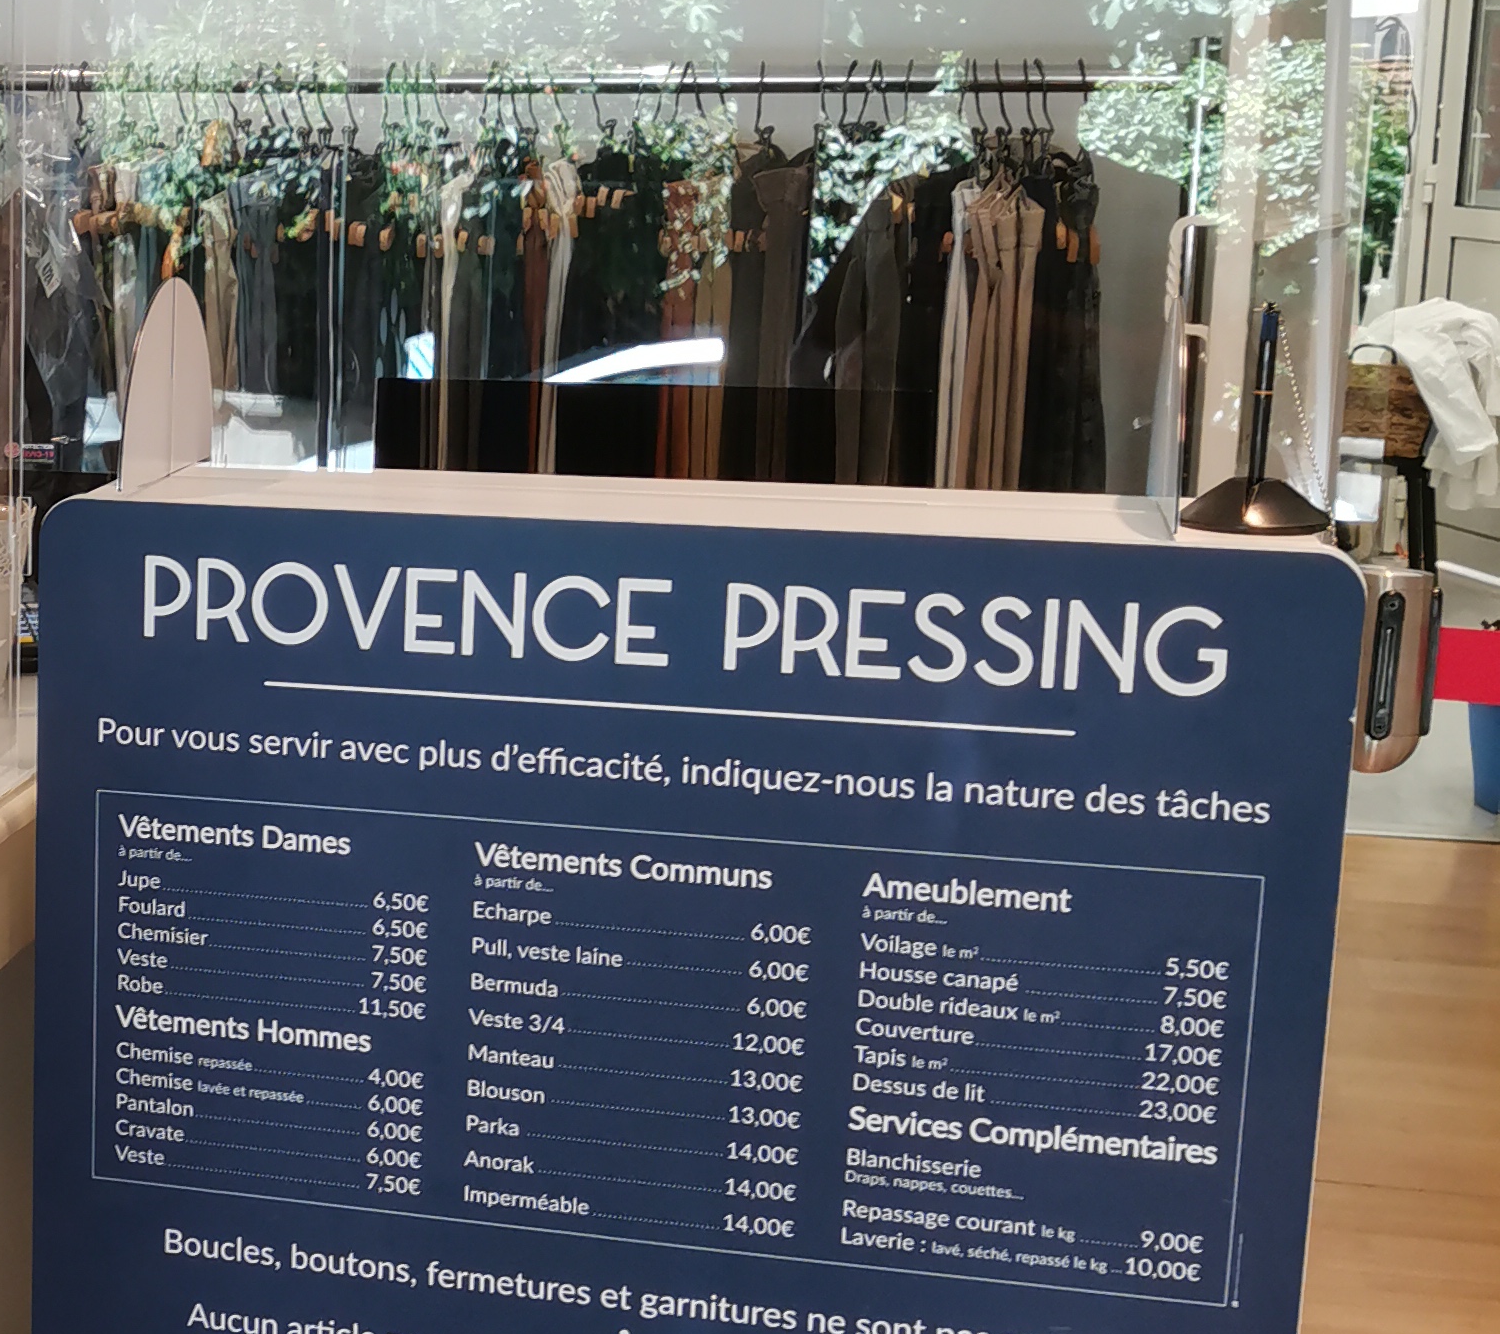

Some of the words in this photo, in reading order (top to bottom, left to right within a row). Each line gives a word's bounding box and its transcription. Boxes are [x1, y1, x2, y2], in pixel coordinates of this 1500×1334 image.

[143, 554, 673, 668] PROVENCE
[722, 581, 1229, 698] PRESSING
[97, 716, 166, 747] Pour
[170, 728, 241, 753] vous
[248, 730, 334, 759] servir
[339, 739, 411, 765] avec
[418, 738, 482, 772] plus
[681, 755, 916, 800] indiquez-nous
[925, 771, 954, 803] la
[963, 779, 1076, 811] nature
[1084, 782, 1146, 816] des
[1155, 788, 1271, 825] tâches
[117, 813, 255, 848] Vêtements
[261, 824, 352, 856] Dames
[474, 841, 623, 878] Vêtements
[629, 853, 773, 890] Communs
[861, 872, 1073, 914] Ameublement
[472, 900, 553, 927] Echarpe
[750, 922, 812, 946] 6,00€
[471, 936, 513, 960] Pull,
[516, 944, 572, 963] veste
[575, 945, 624, 968] laine
[748, 959, 810, 983] 6,00€
[859, 931, 938, 960] Voilage
[1164, 956, 1230, 981] 5,50€
[117, 973, 164, 995] Robe
[358, 996, 427, 1021] 11,50€
[857, 988, 935, 1014] Double
[938, 995, 1020, 1021] rideaux
[1159, 1014, 1226, 1039] 8,00€
[114, 1003, 251, 1041] Vêtements
[256, 1017, 372, 1053] Hommes
[467, 1007, 525, 1031] Veste
[527, 1013, 566, 1035] 3/4
[732, 1032, 806, 1057] 12,00€
[115, 1040, 195, 1066] Chemise
[367, 1067, 425, 1090] 4,00€
[115, 1066, 194, 1092] Chemise
[367, 1093, 424, 1117] 6,00€
[851, 1072, 928, 1098] Dessus
[931, 1080, 960, 1101] de
[963, 1082, 987, 1104] lit
[1138, 1099, 1218, 1125] 23,00€
[847, 1105, 964, 1141] Services
[968, 1116, 1219, 1166] Complémentaires
[843, 1168, 891, 1188] Draps,
[892, 1176, 949, 1194] nappes,
[845, 1147, 983, 1179] Blanchisserie
[463, 1184, 590, 1216] Imperméable
[722, 1213, 796, 1239] 14,00€
[841, 1198, 951, 1231] Repassage
[954, 1214, 1038, 1238] courant
[1140, 1229, 1205, 1255] 9,00€
[163, 1227, 282, 1271] Boucles,
[290, 1242, 418, 1288] boutons,
[425, 1260, 592, 1306] fermetures
[599, 1285, 633, 1311] et
[638, 1293, 798, 1331] garnitures
[840, 1225, 916, 1252] Laverie
[930, 1240, 965, 1259] lavé,
[966, 1245, 1013, 1264] séché,
[1014, 1252, 1071, 1269] repassé
[1124, 1256, 1202, 1283] 10,00€
